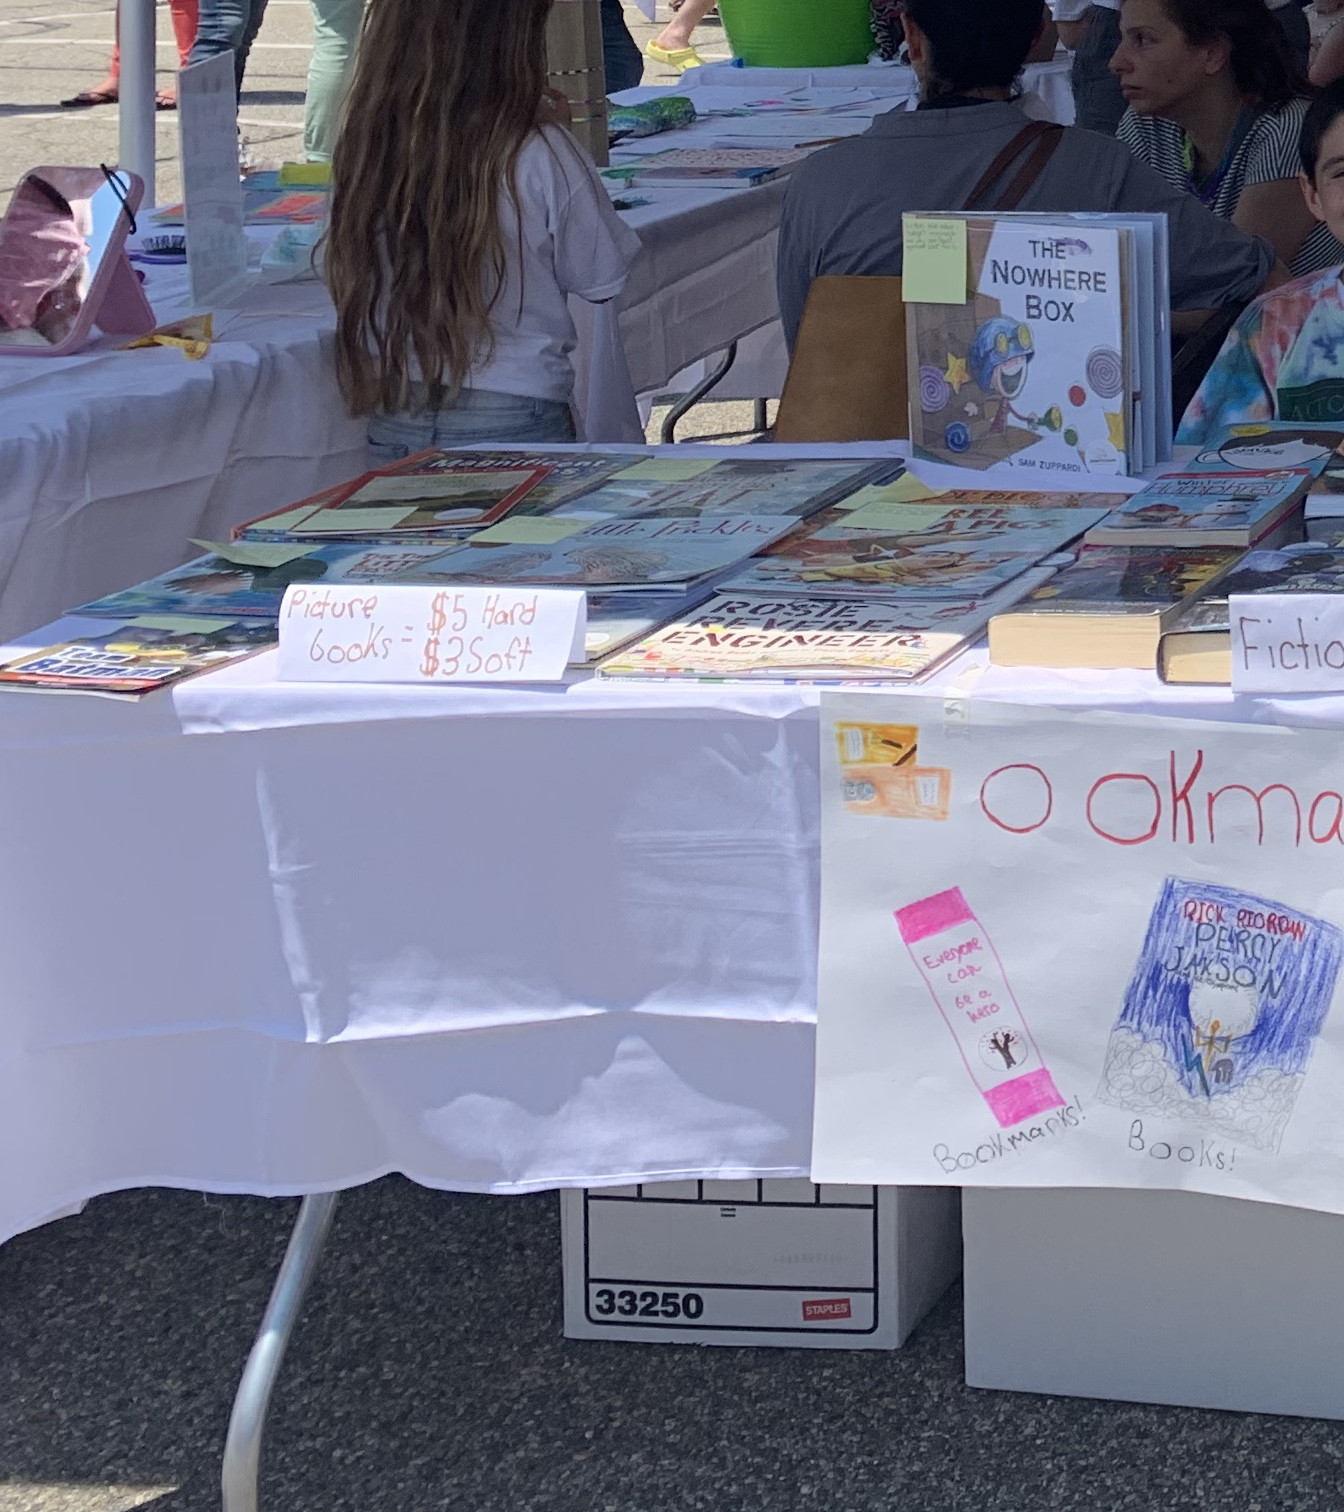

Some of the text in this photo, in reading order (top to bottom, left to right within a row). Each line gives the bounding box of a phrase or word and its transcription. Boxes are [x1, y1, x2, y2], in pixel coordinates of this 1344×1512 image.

[1028, 239, 1067, 260] THE
[1018, 458, 1081, 474] SAM ZUPPARDI
[286, 589, 378, 620] Picture
[427, 591, 539, 635] $5 Hard
[709, 599, 871, 619] ROSIE
[685, 614, 897, 633] REVERE
[661, 630, 923, 649] ENGINEER
[20, 658, 180, 679] Batman
[1183, 898, 1225, 924] RICK
[922, 937, 983, 970] Everyone
[1194, 922, 1281, 964] PERCY
[947, 964, 983, 984] can
[955, 989, 993, 1009] be a
[933, 1095, 1088, 1175] Bookmarks!
[1127, 1118, 1237, 1173] Books!
[595, 1288, 704, 1320] 33250
[805, 1302, 849, 1317] STAPLES
